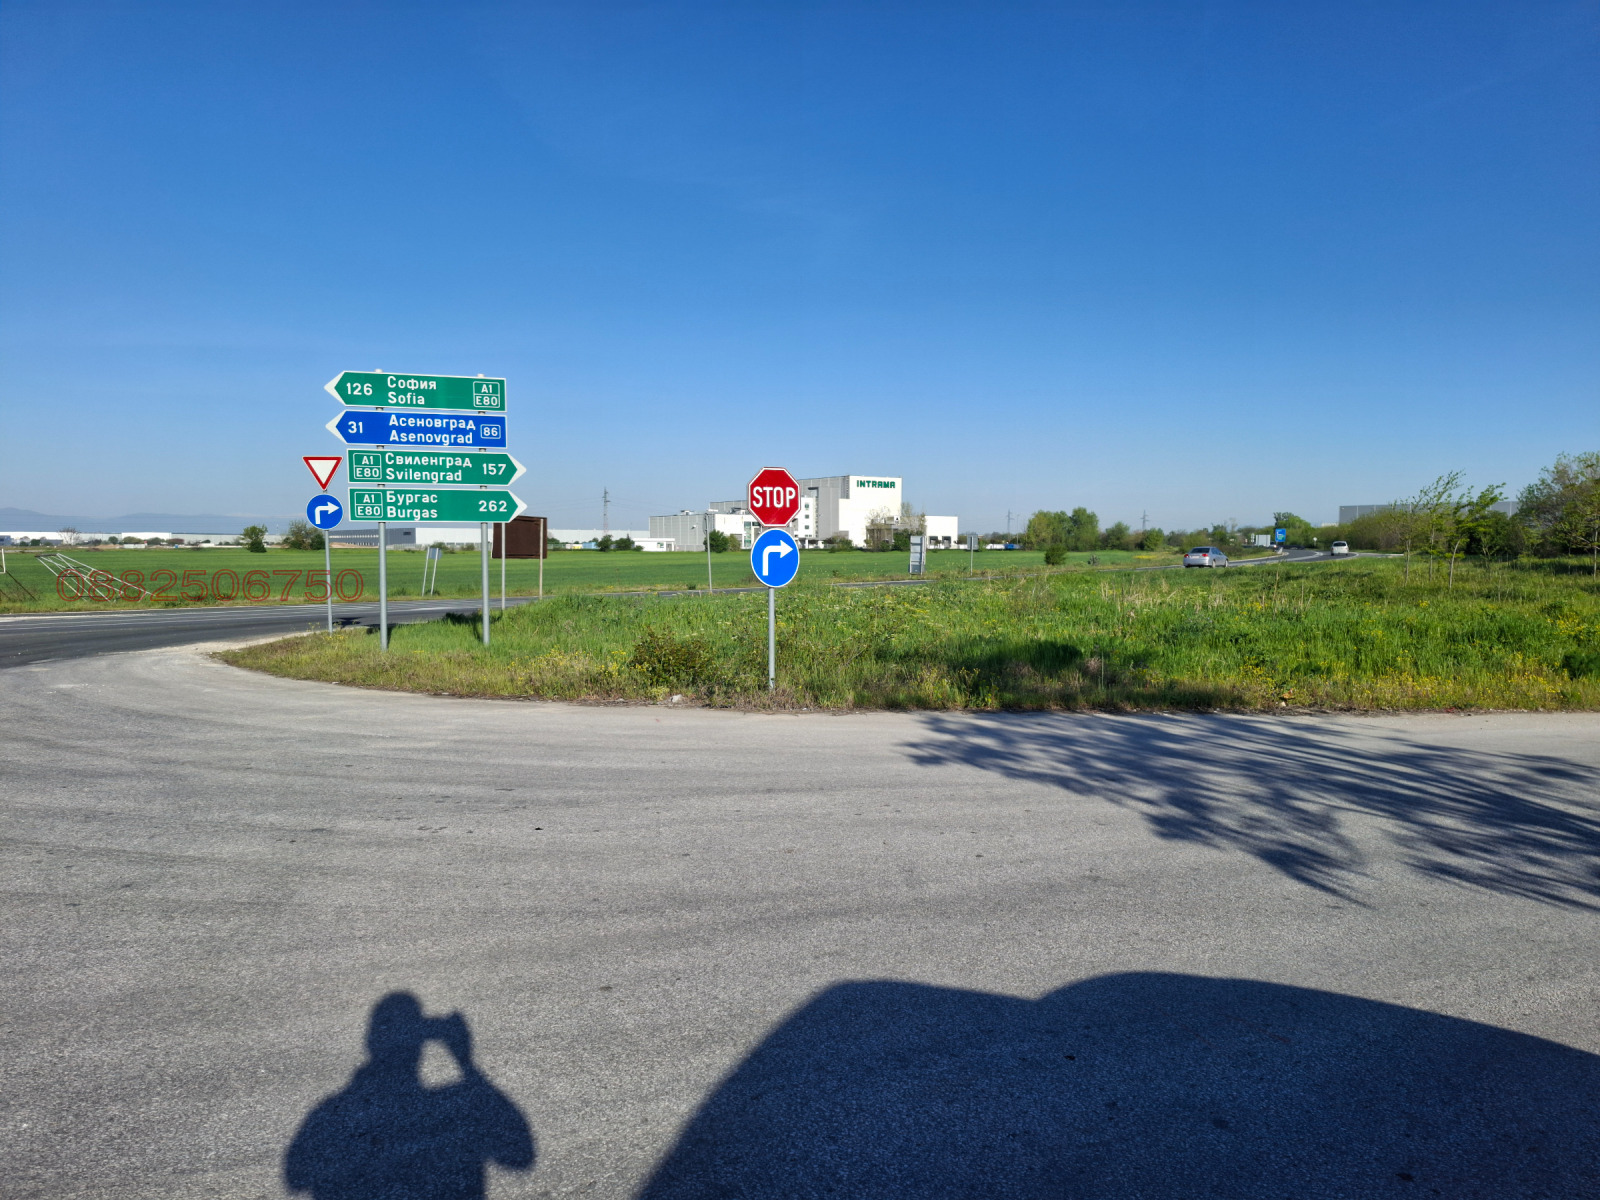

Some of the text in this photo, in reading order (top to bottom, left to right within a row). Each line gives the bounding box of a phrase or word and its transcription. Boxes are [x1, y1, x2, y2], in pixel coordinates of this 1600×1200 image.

[387, 376, 436, 390] София
[481, 384, 493, 393] A1
[346, 383, 372, 395] 126
[388, 392, 424, 405] Sofia
[476, 396, 498, 406] E80
[348, 422, 363, 433] 31
[389, 415, 476, 431] Асеновград
[483, 427, 498, 436] 86
[390, 430, 472, 446] Asenovgrad
[362, 455, 374, 464] A1
[386, 453, 472, 468] Свиленград
[357, 468, 379, 477] E80
[483, 464, 506, 475] 157
[386, 469, 462, 483] Svilengrad
[856, 480, 895, 488] INTRAMA
[363, 494, 375, 503] A1
[386, 491, 437, 506] Бургас
[752, 486, 796, 508] STOP
[358, 507, 380, 516] E80
[479, 501, 507, 512] 262
[387, 507, 437, 521] Burgas
